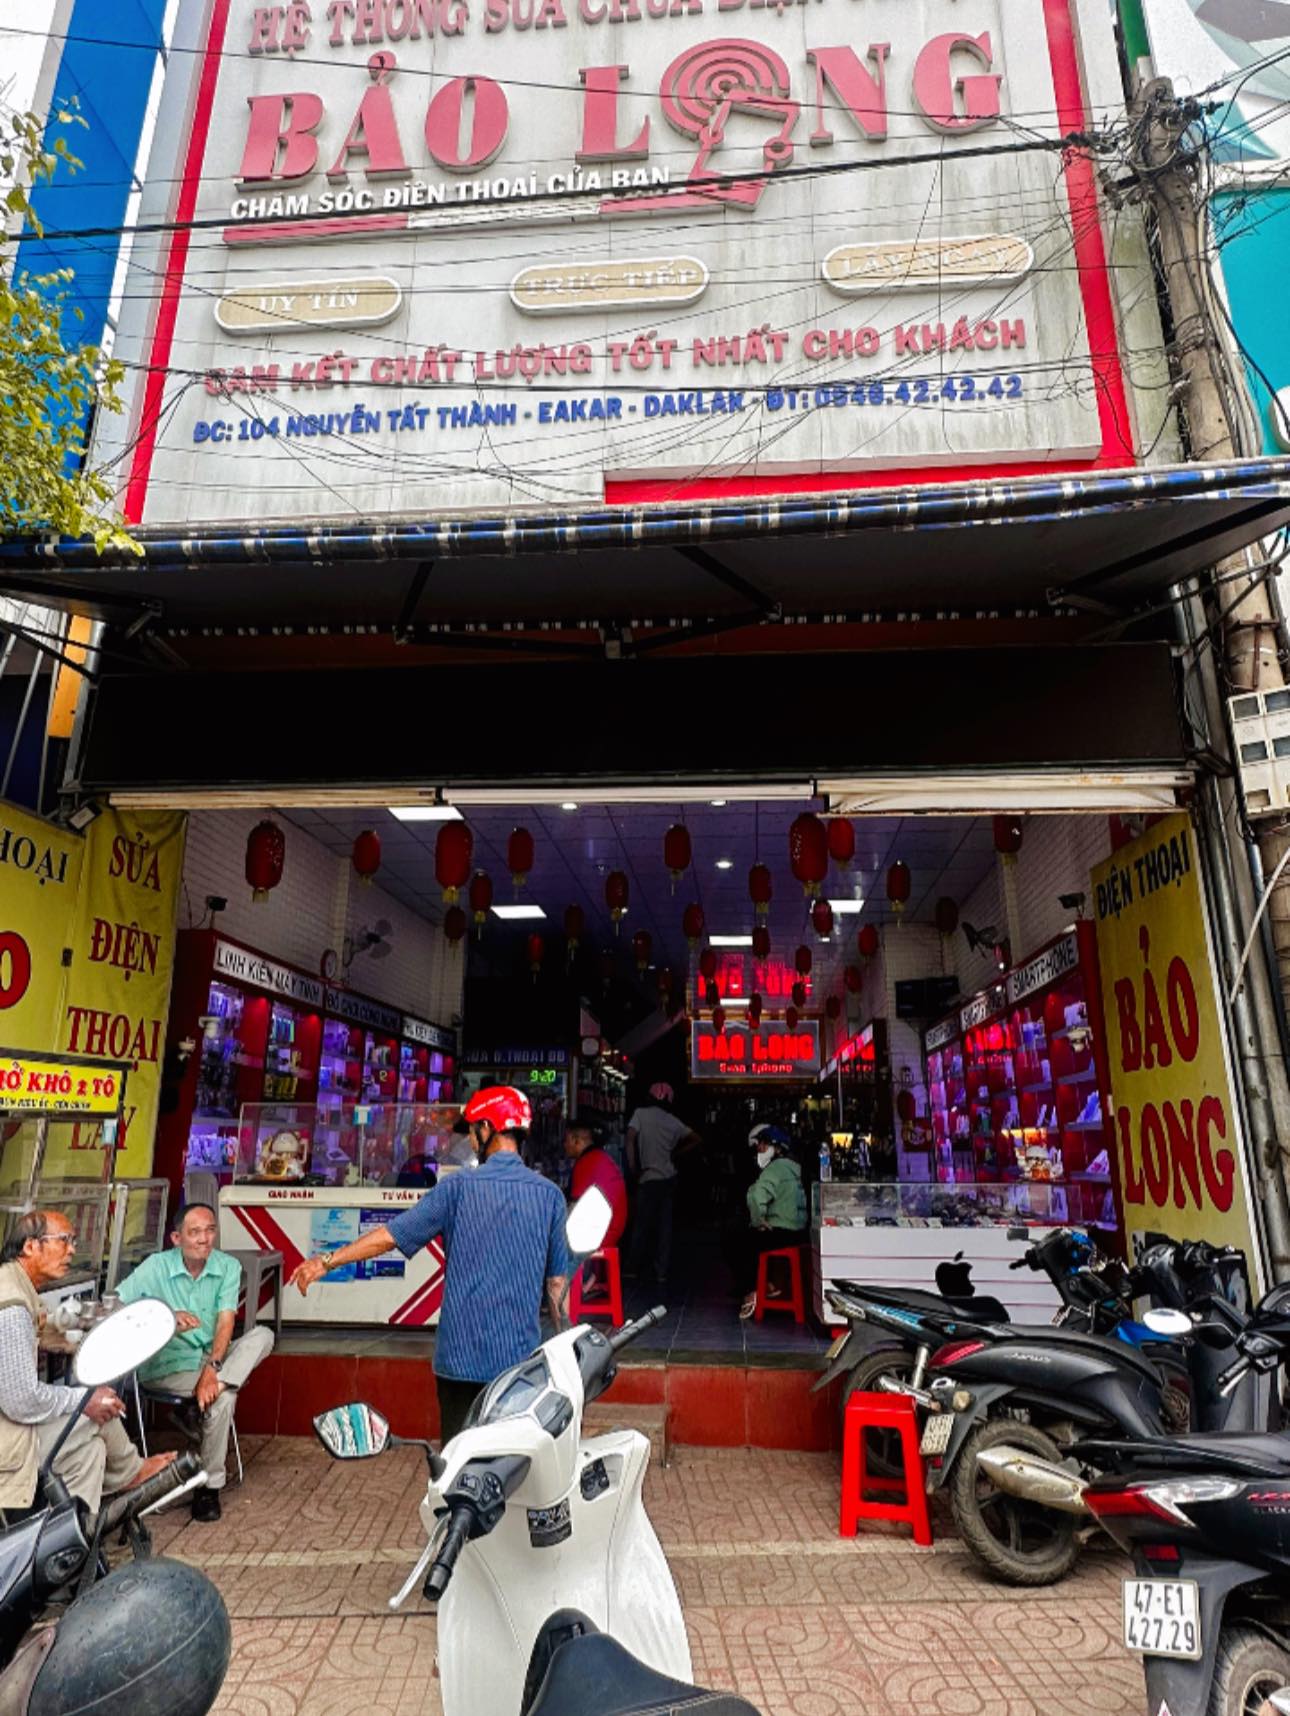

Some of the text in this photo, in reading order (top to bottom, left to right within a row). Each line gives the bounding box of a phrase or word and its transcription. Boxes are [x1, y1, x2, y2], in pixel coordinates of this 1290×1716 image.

[234, 50, 510, 190] BẢO
[318, 187, 373, 213] SÓC
[547, 164, 602, 193] CỦA
[259, 286, 359, 314] UY TÍN
[291, 350, 358, 392] KẾT
[370, 343, 463, 384] CHẤT
[475, 343, 592, 383] LƯỢNG
[607, 330, 677, 372] TỐT
[693, 323, 790, 367] NHẤT
[803, 326, 881, 361] CHO
[895, 315, 1027, 354] KHÁCH
[238, 416, 280, 439] 104
[286, 403, 382, 436] NGUYỄN
[388, 401, 430, 431] TẤT
[437, 399, 517, 429] THÀNH
[538, 397, 622, 424] EAKAR
[644, 391, 746, 417] DAKLAK
[109, 831, 162, 892] SỬA
[1095, 829, 1192, 922] ĐIỆN THOẠI
[88, 918, 162, 982] ĐIỆN
[1114, 925, 1200, 1072] BẢO
[66, 1006, 162, 1071] THOẠI
[27, 1070, 72, 1094] KHÔ
[76, 1079, 87, 1097] 2
[92, 1074, 115, 1098] TÔ
[1117, 1095, 1236, 1213] LONG
[1133, 1584, 1185, 1617] 47-E1
[1128, 1614, 1196, 1652] 427.29
